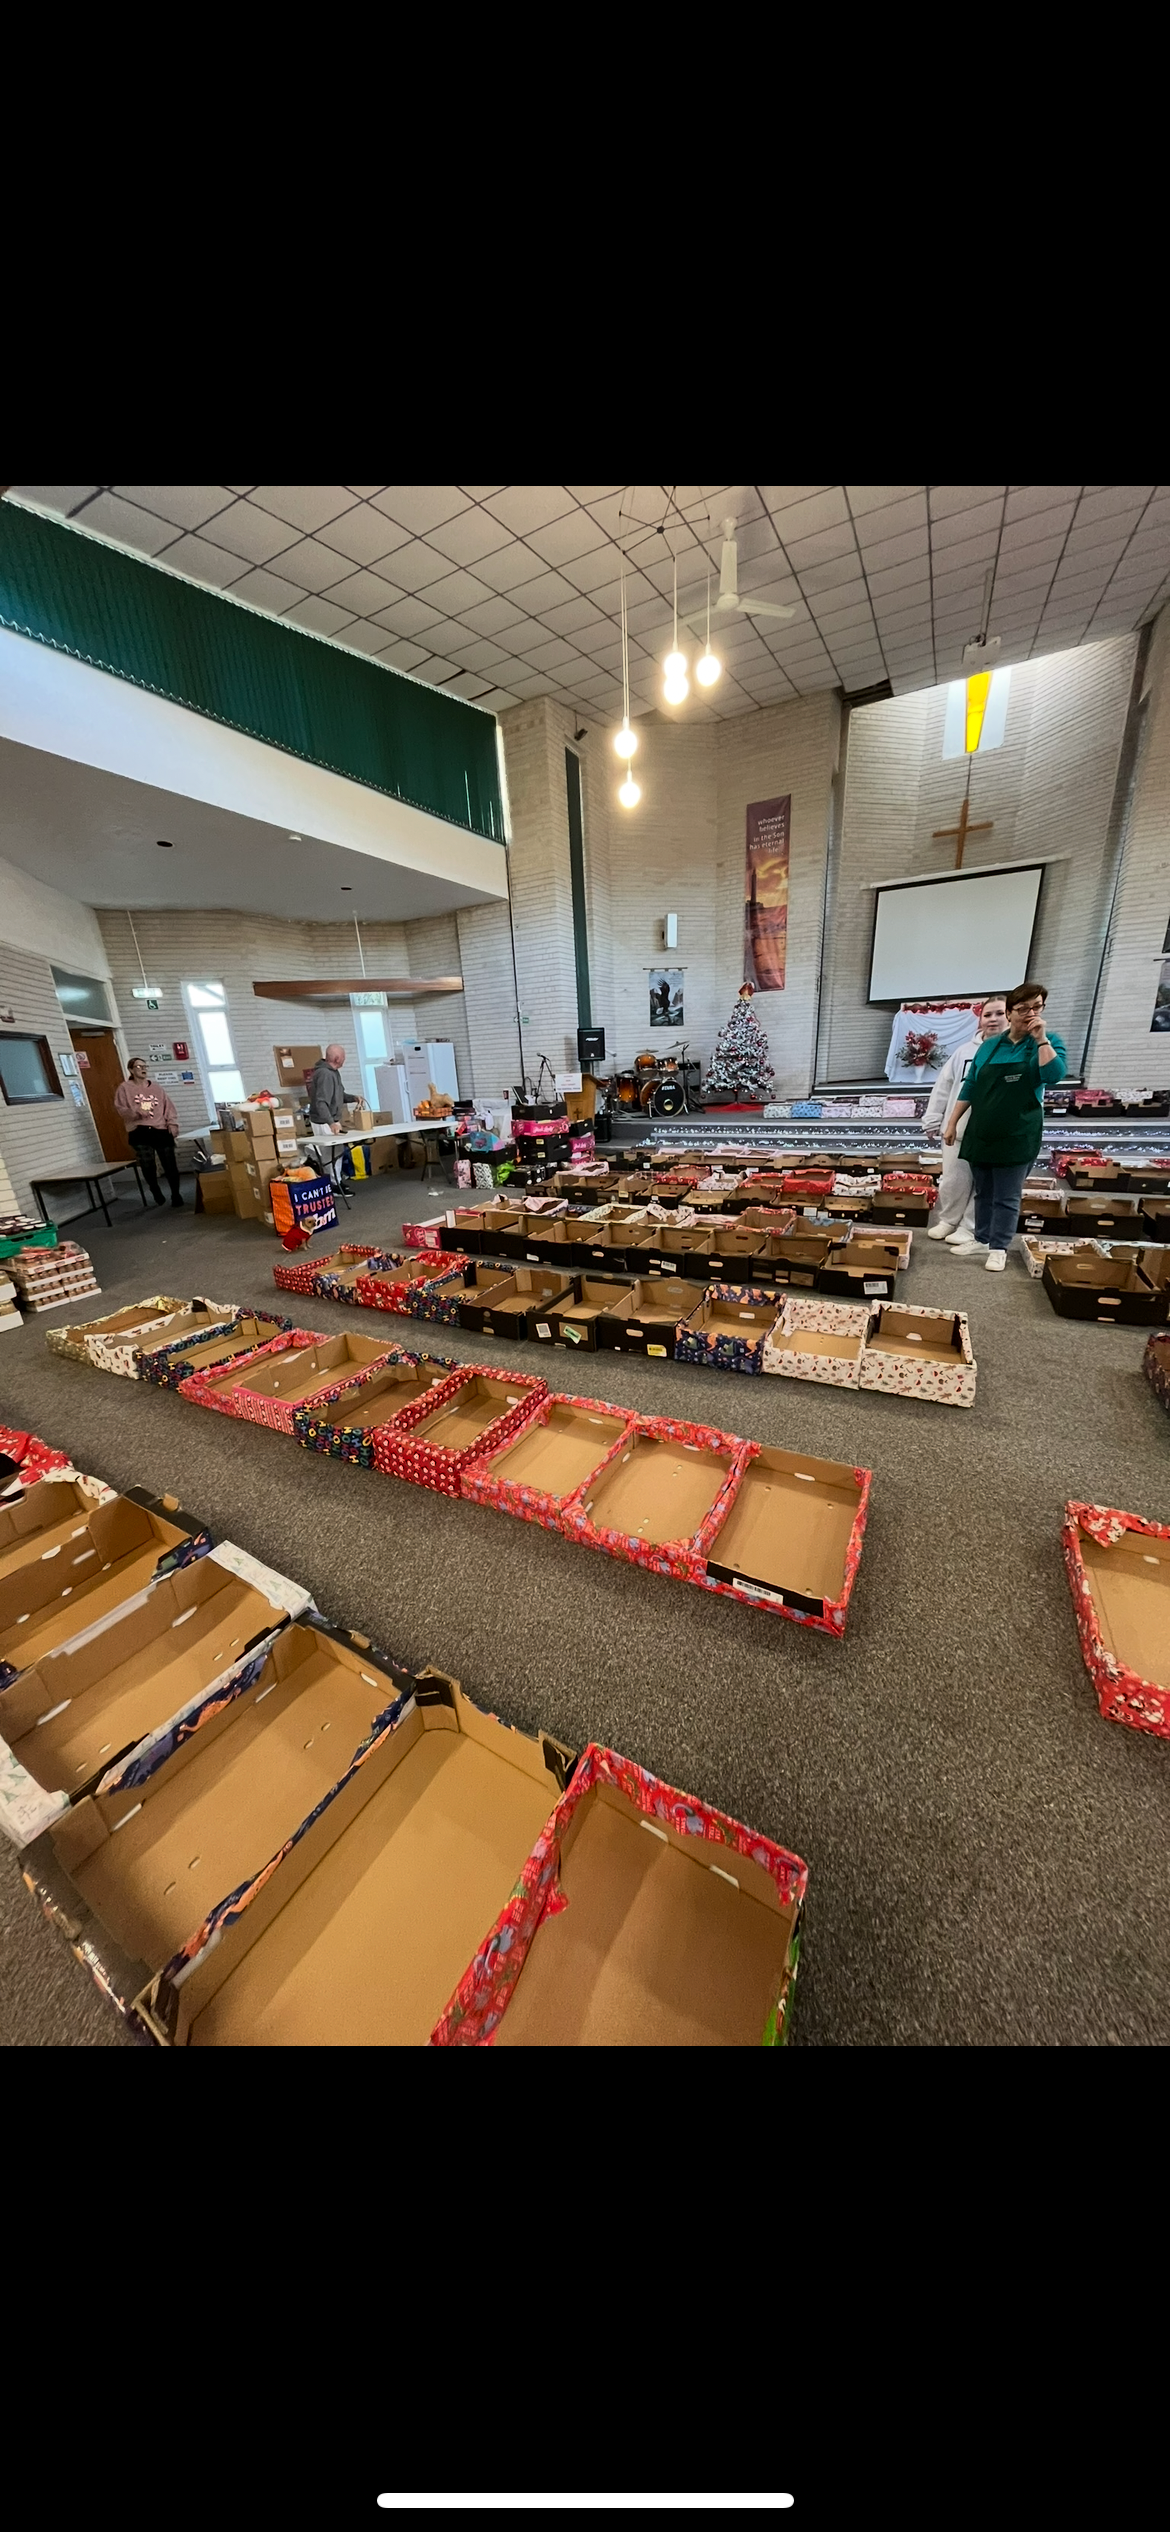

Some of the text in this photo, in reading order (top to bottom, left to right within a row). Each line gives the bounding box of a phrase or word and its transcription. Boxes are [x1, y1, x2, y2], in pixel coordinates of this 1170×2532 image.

[758, 815, 784, 825] whoever
[759, 822, 784, 832] believes
[761, 838, 784, 847] eternal
[294, 1193, 298, 1202] I
[301, 1187, 323, 1200] CAN'T
